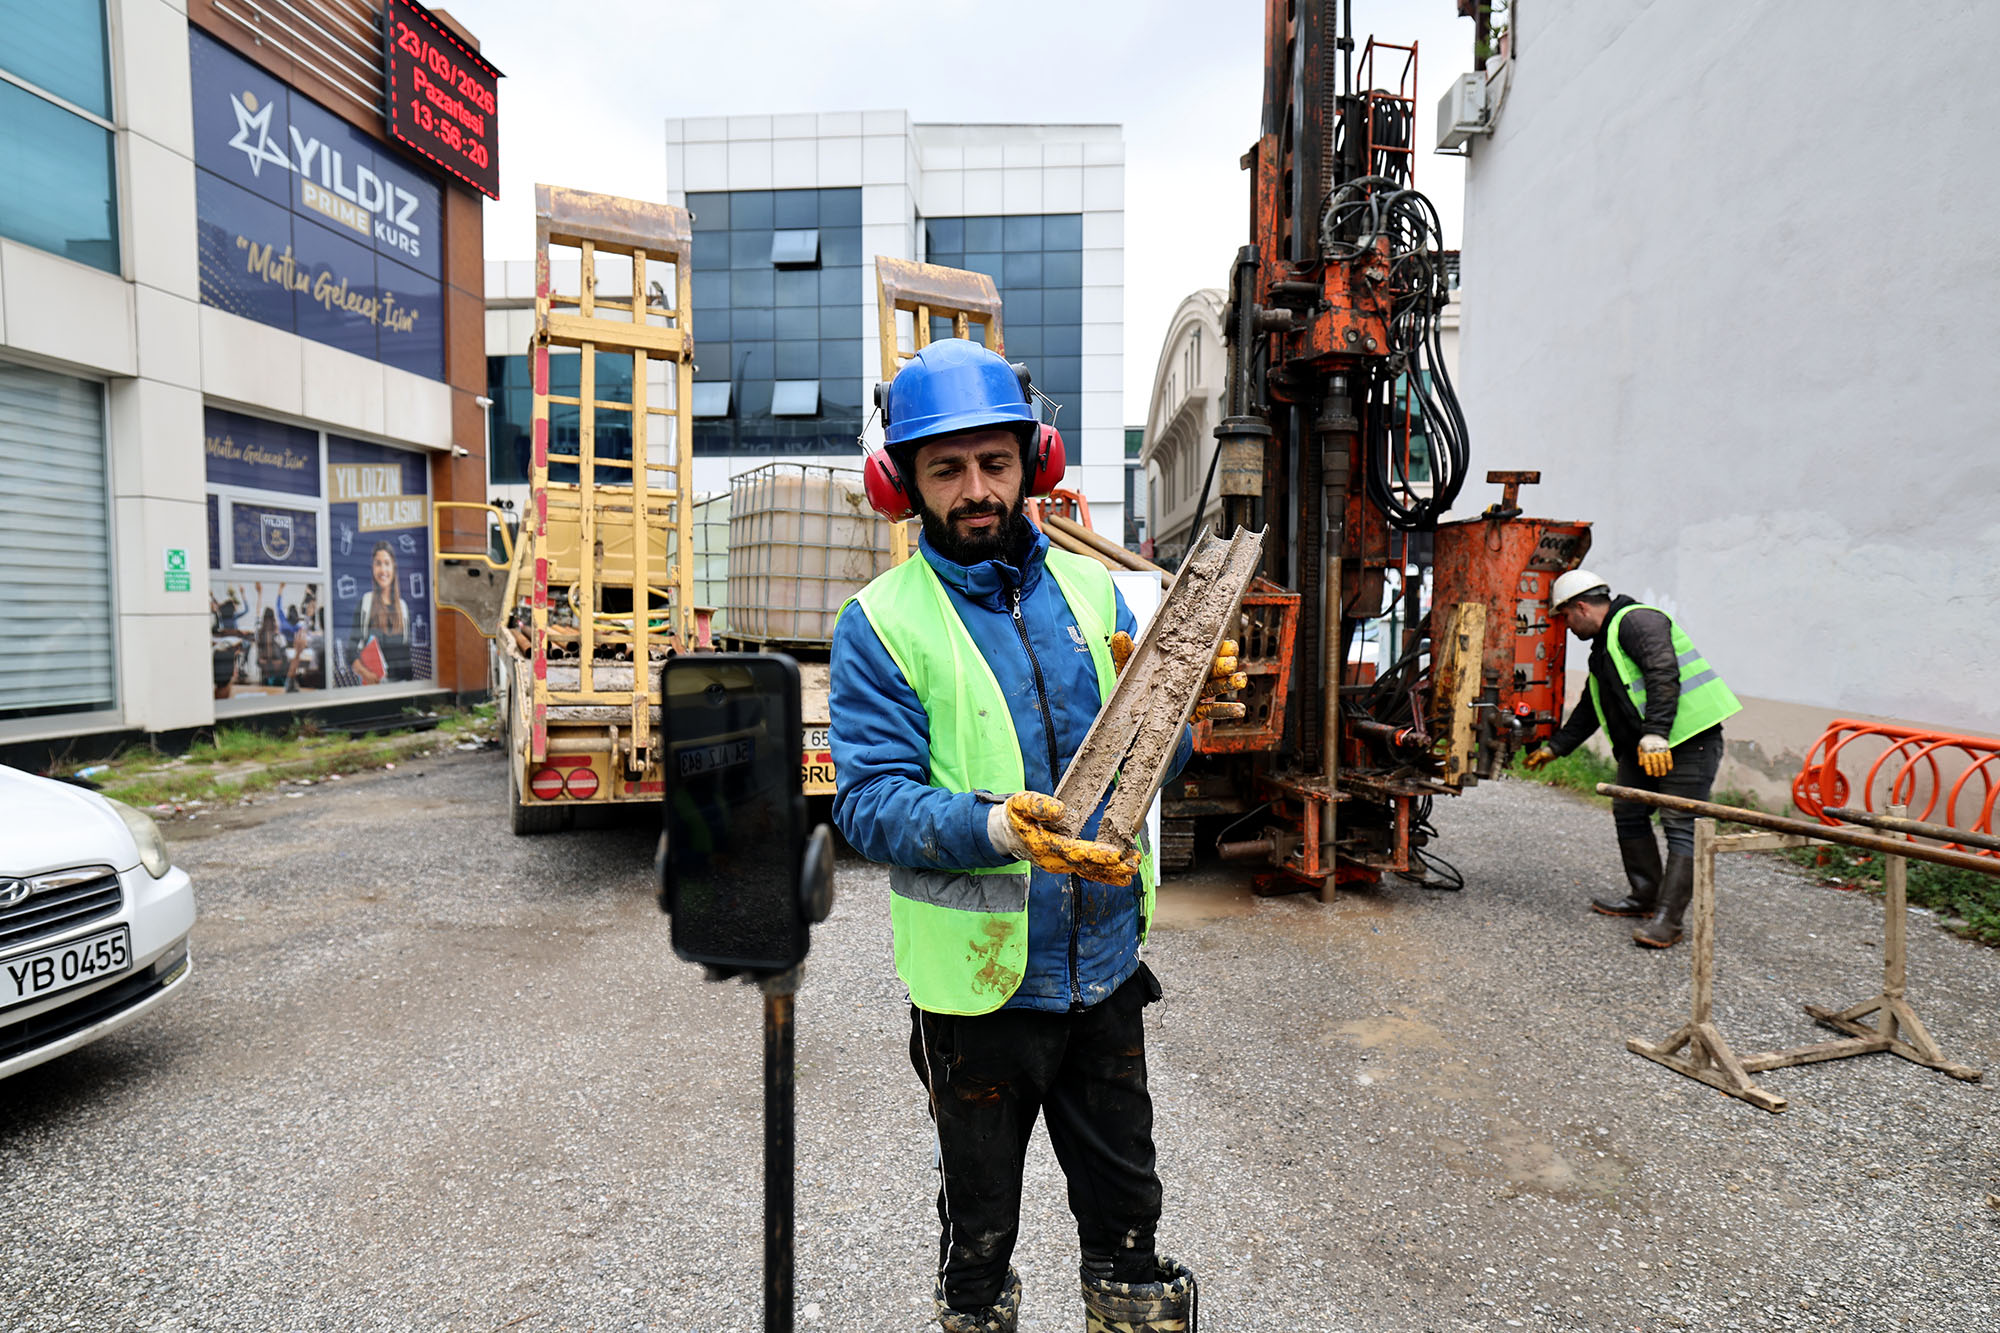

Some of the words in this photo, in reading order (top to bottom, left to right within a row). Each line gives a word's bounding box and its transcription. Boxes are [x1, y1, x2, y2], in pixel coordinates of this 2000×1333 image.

[397, 21, 495, 115] 23/03/2026
[413, 66, 485, 138] Pazartesi
[411, 99, 488, 169] 13:56:20
[289, 124, 420, 236] YILDIZ
[303, 182, 370, 233] PRIME
[374, 219, 420, 258] KURS
[313, 271, 382, 325] Gelecek
[336, 467, 401, 499] YILDIZIN
[263, 517, 290, 529] YILDIZ
[7, 956, 55, 996] YB
[61, 935, 126, 981] 0455
